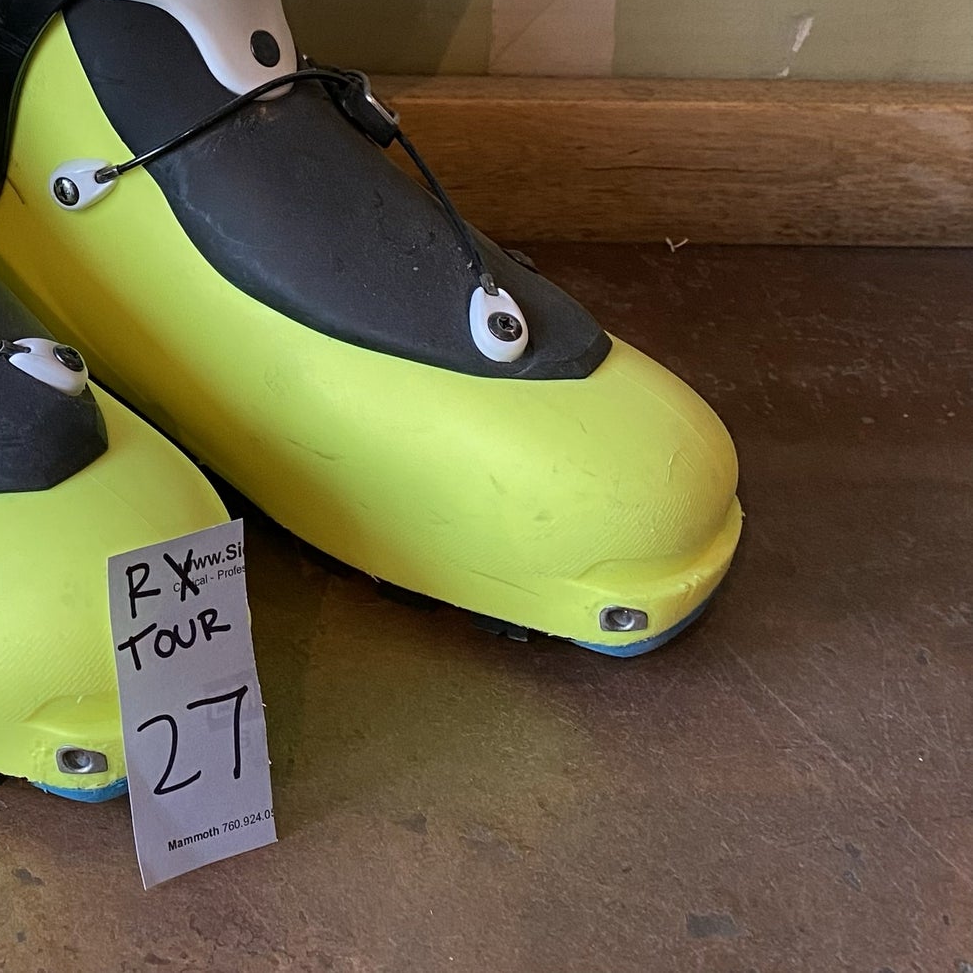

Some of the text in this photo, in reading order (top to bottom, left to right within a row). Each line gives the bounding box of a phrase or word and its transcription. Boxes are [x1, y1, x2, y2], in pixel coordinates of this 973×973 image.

[117, 607, 232, 670] TOUR
[137, 684, 249, 796] 27
[167, 827, 220, 852] Mammoth
